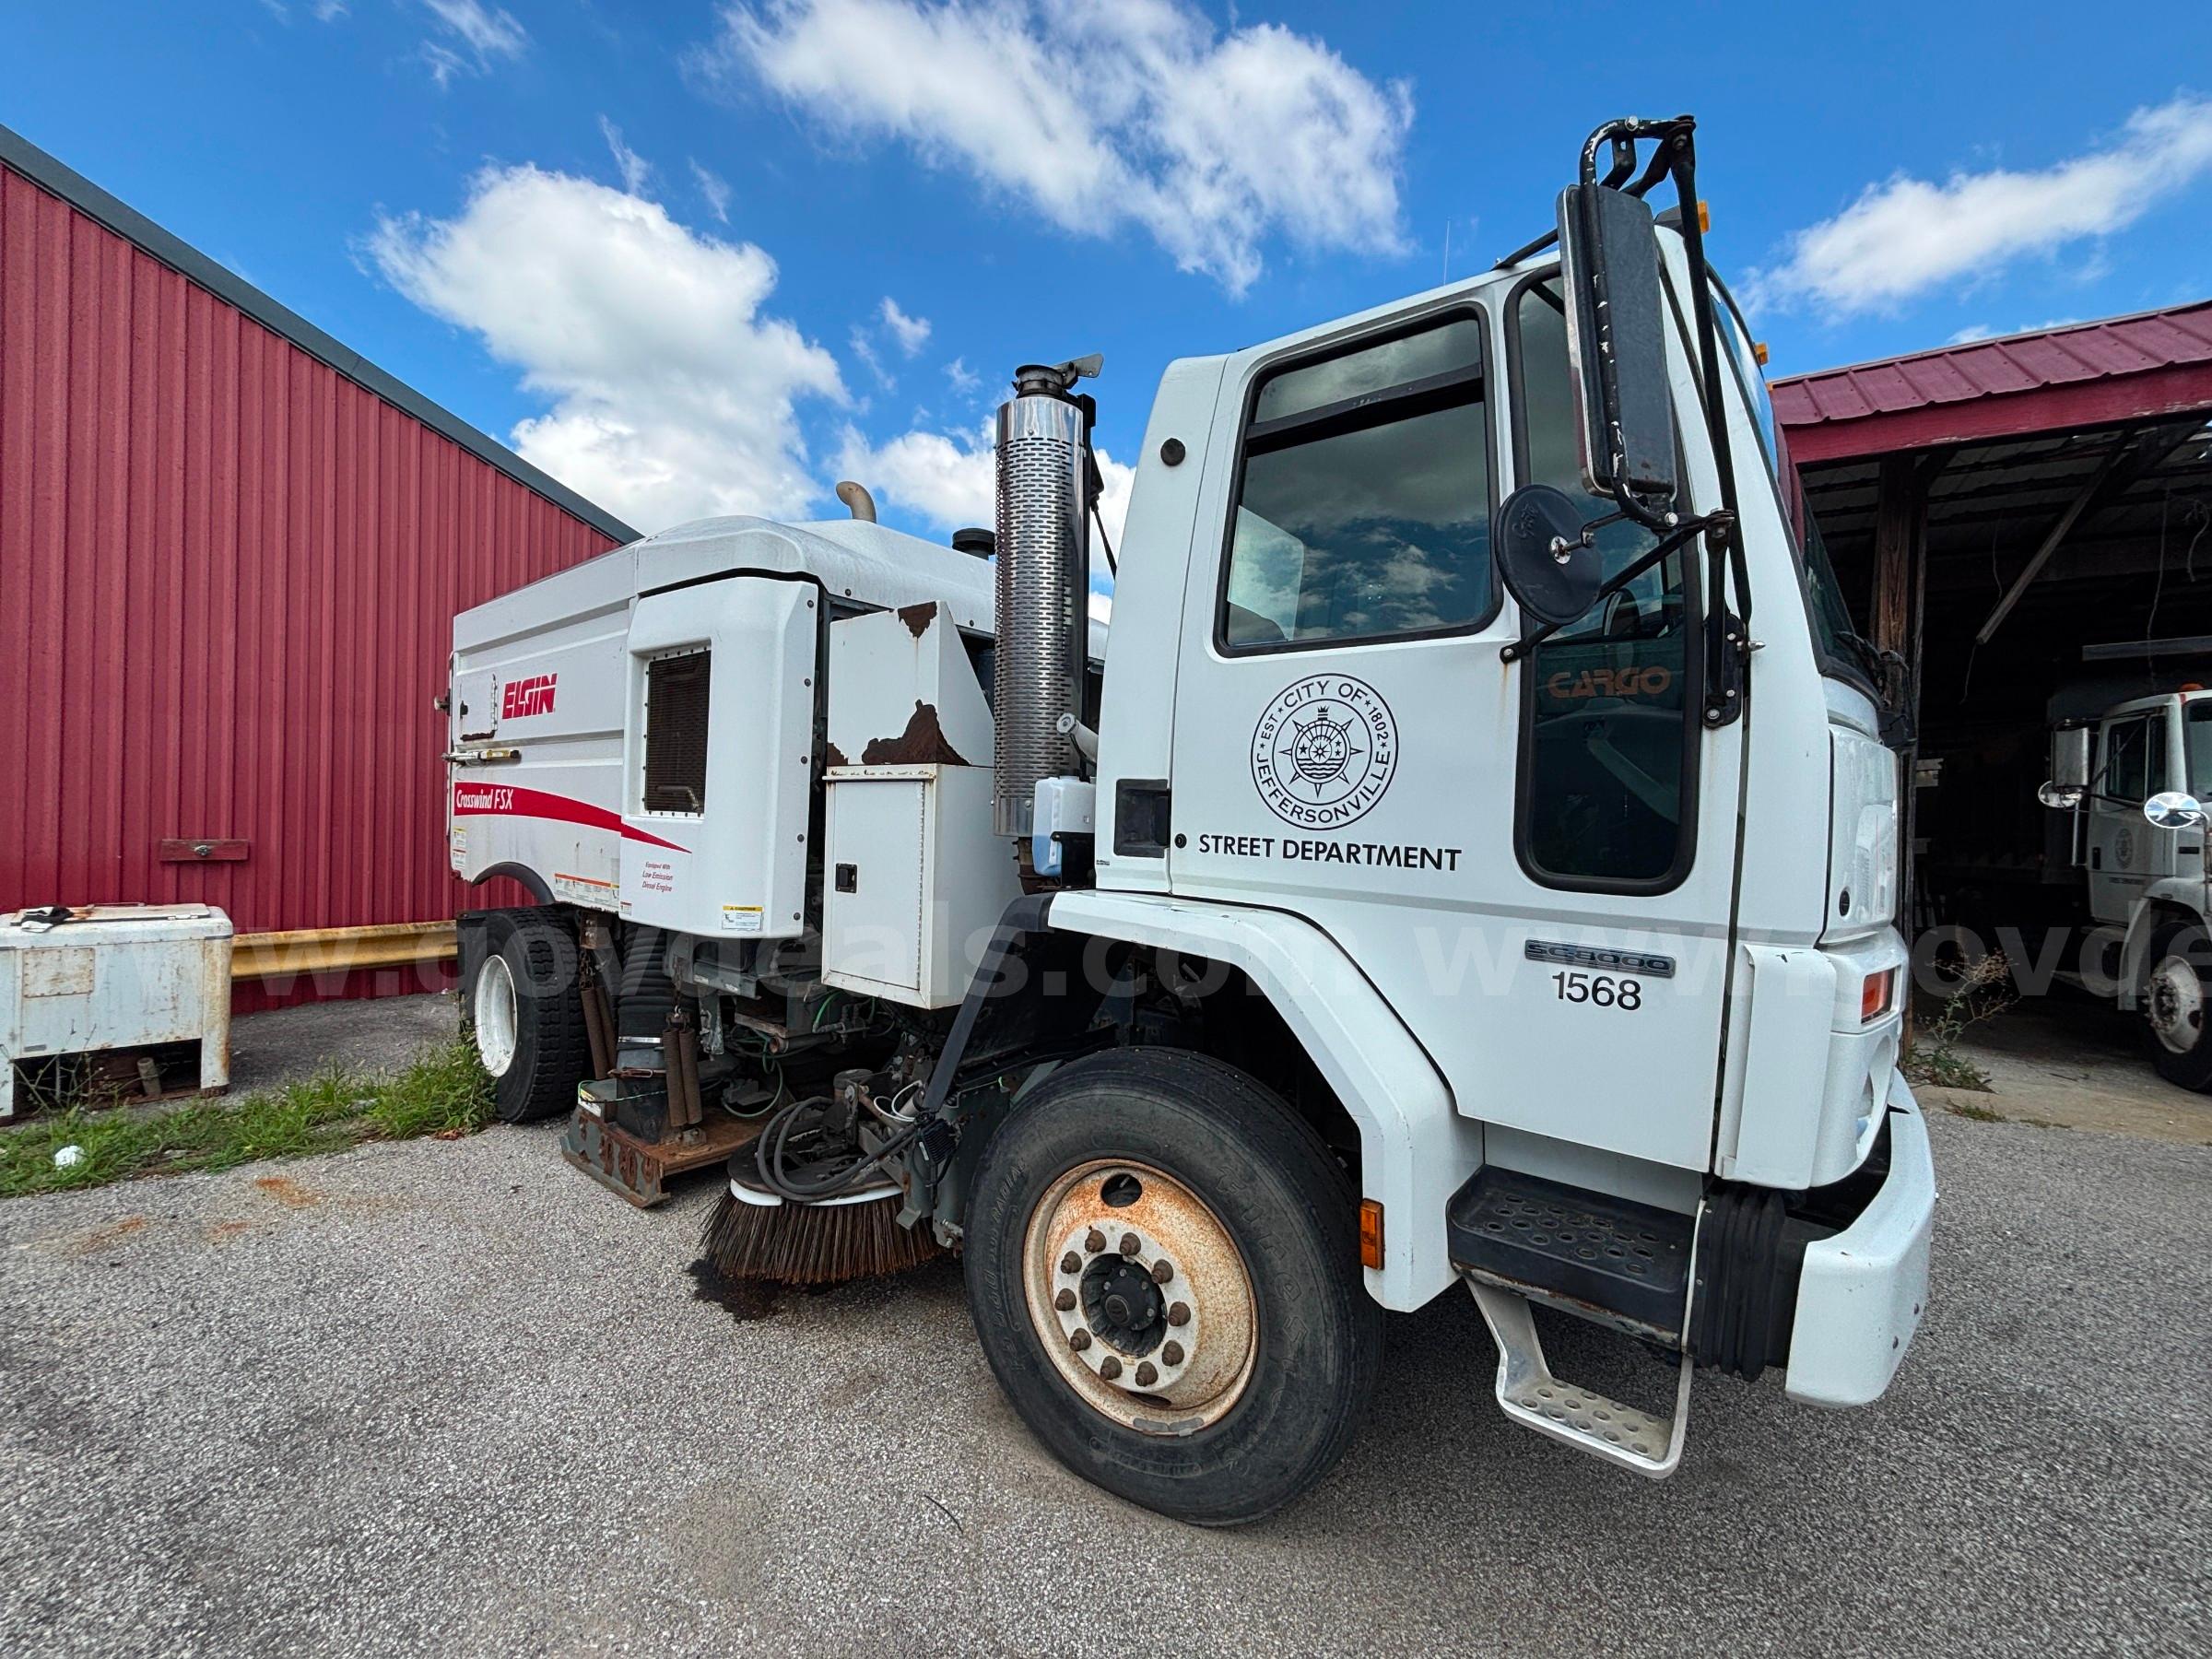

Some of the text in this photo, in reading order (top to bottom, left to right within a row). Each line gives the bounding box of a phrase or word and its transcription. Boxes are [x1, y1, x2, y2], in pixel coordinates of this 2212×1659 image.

[502, 673, 558, 719] ELGIN
[1284, 680, 1369, 708] CITY OF
[1548, 665, 1671, 699] CARGO
[1261, 714, 1279, 740] EST
[1369, 707, 1389, 740] 1802
[456, 789, 513, 809] Crosswind FSX
[1257, 751, 1391, 823] JEFFERSONVILLE
[1198, 834, 1462, 871] STREET DEPARTMENT
[1528, 944, 1669, 970] SC8000
[1552, 971, 1641, 1010] 1568
